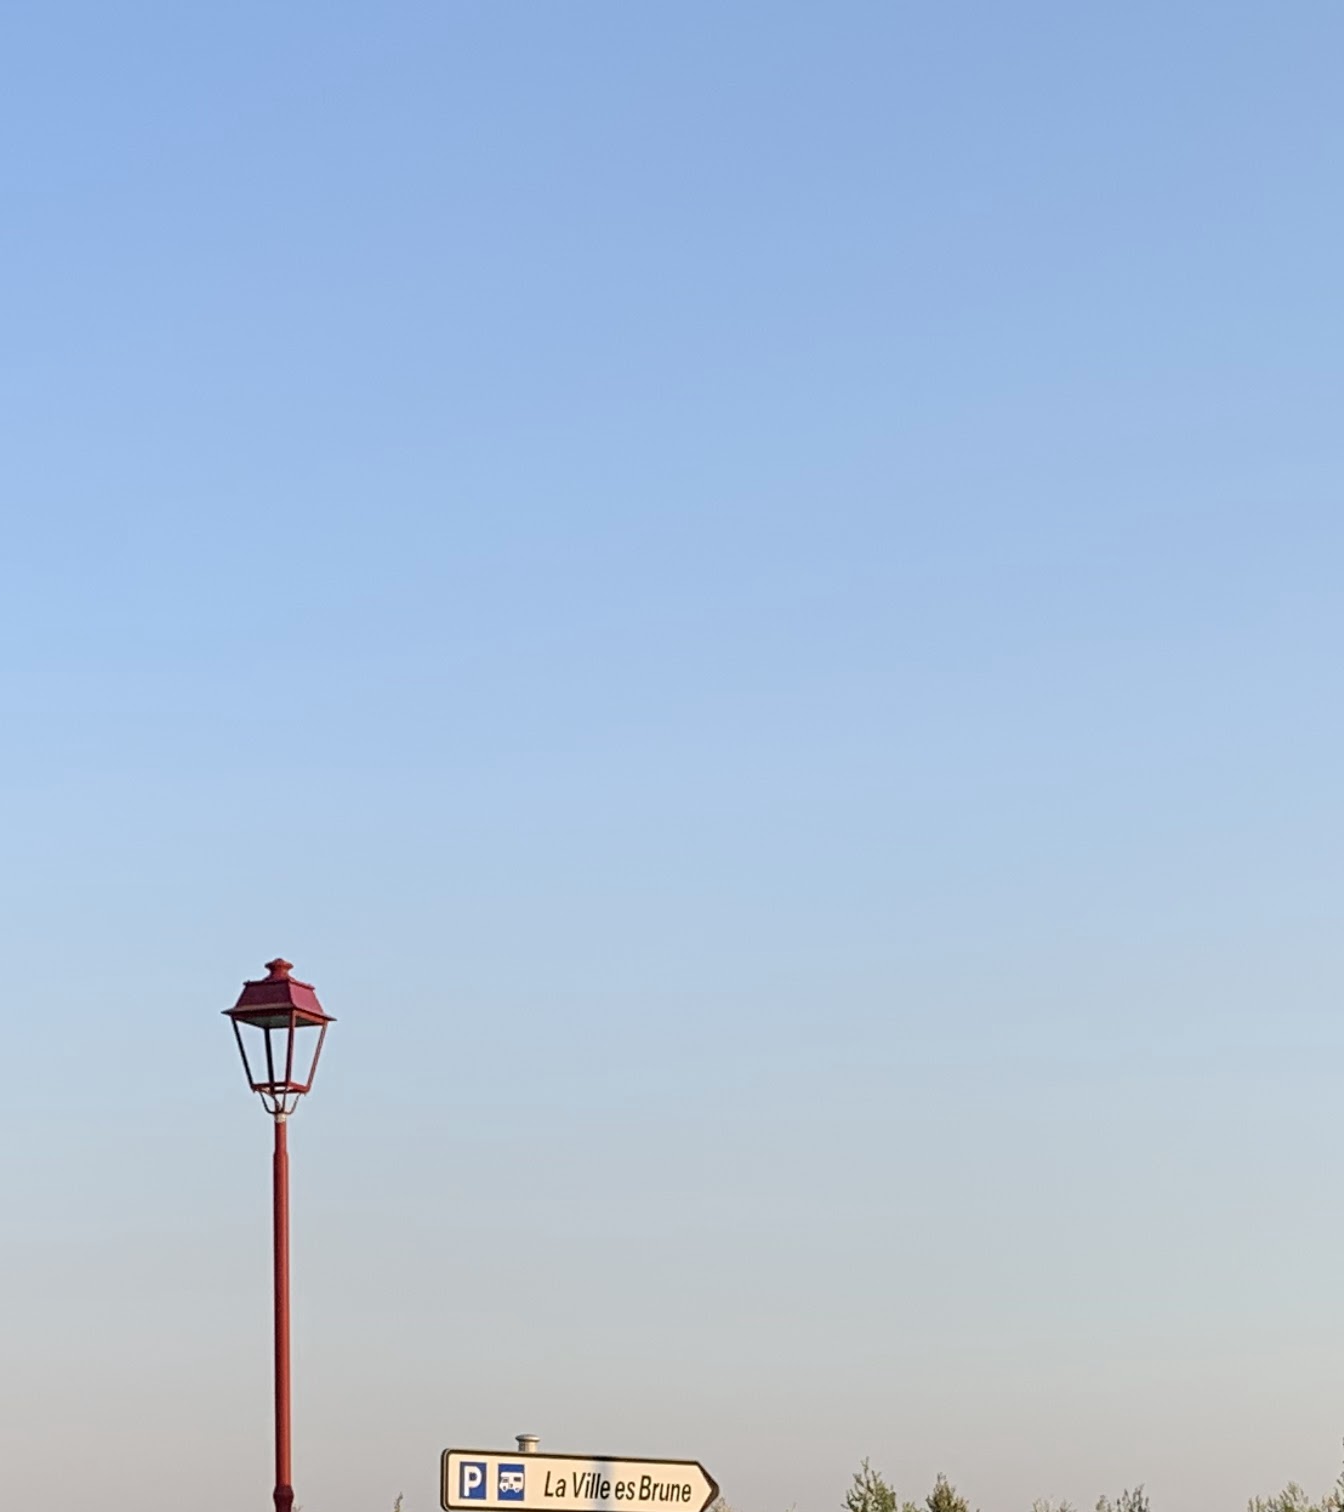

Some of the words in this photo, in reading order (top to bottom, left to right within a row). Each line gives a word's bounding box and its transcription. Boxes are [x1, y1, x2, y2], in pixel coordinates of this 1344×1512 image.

[464, 1465, 482, 1497] P
[544, 1471, 567, 1498] La
[573, 1471, 610, 1499] Ville
[614, 1480, 635, 1500] es
[638, 1475, 692, 1502] Brune
